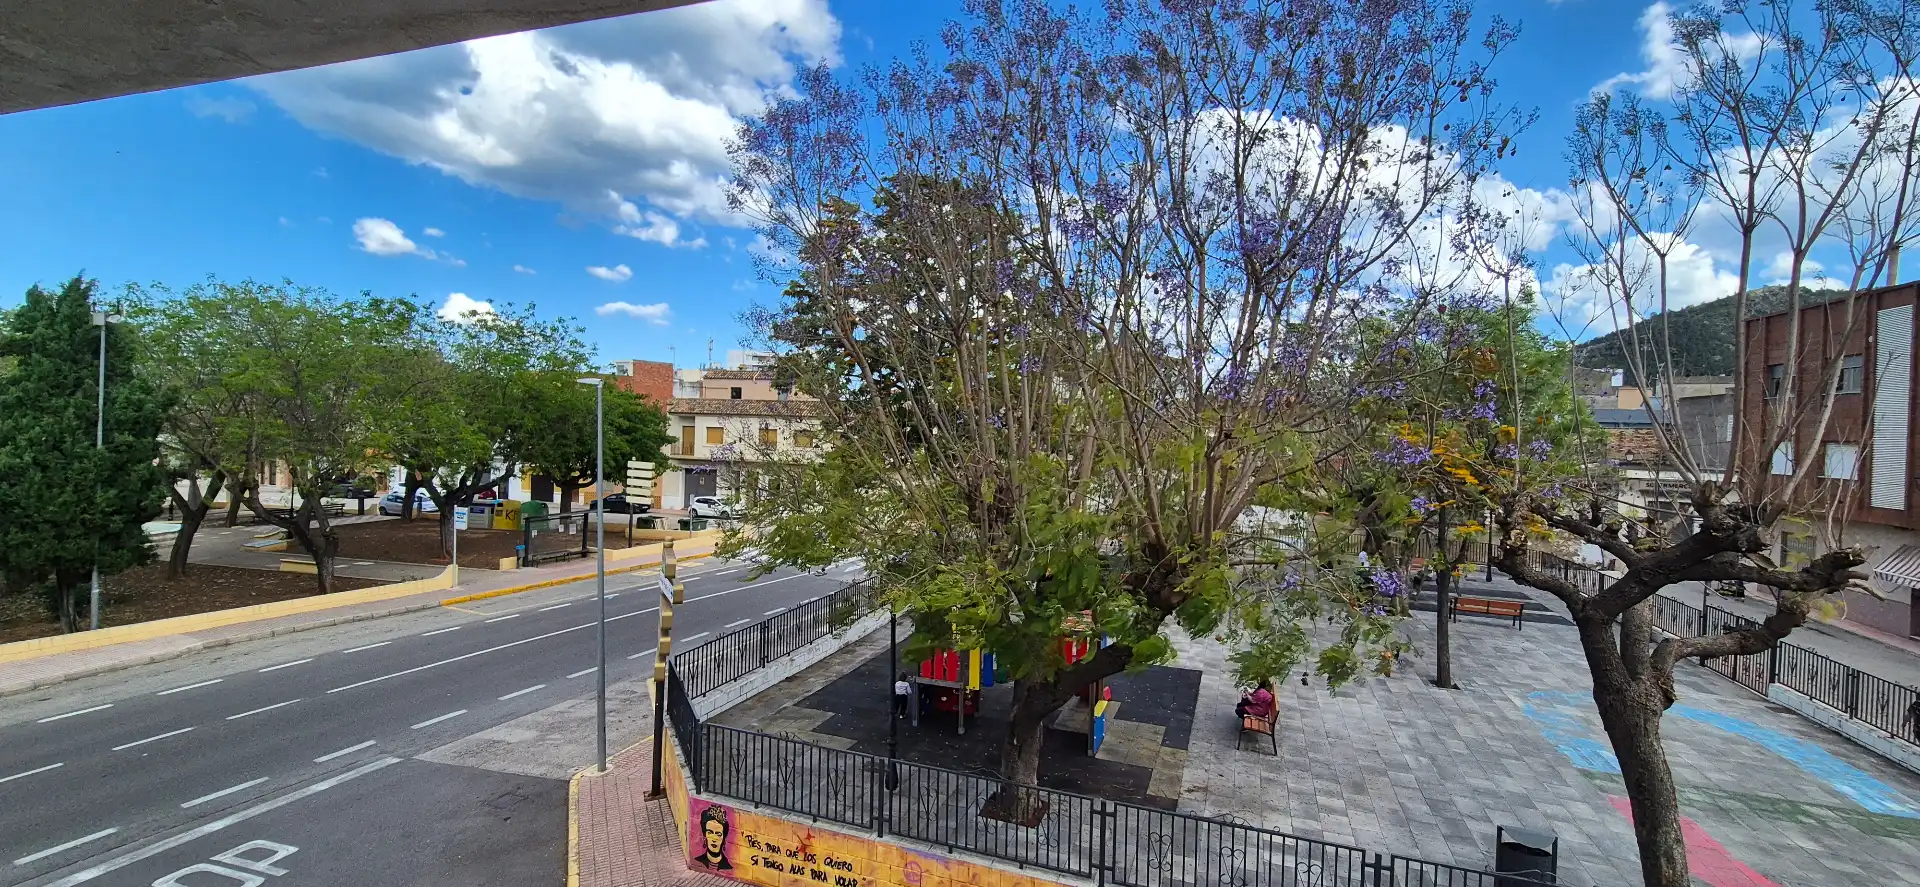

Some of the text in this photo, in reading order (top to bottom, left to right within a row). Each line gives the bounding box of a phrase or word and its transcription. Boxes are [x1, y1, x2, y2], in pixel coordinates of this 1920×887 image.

[765, 842, 781, 855] PARA
[786, 846, 799, 858] QUÉ
[804, 852, 817, 864] LOS
[762, 857, 784, 871] TENGO
[789, 864, 805, 875] ALAS
[810, 868, 828, 882] PARA
